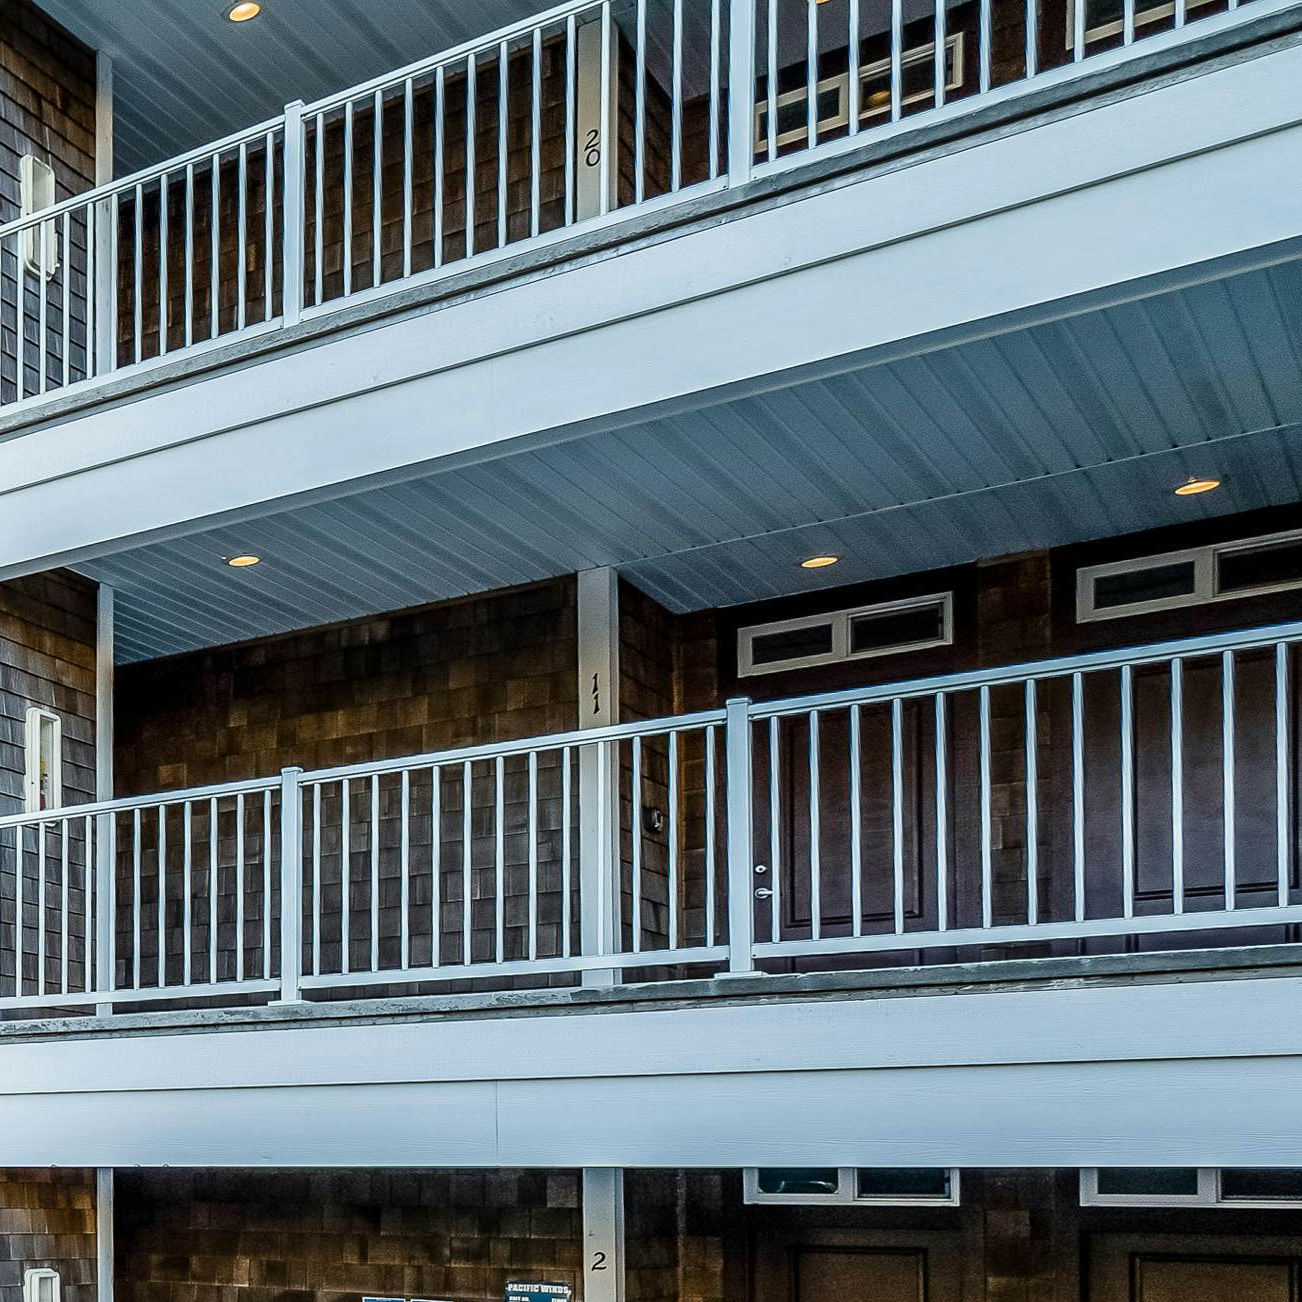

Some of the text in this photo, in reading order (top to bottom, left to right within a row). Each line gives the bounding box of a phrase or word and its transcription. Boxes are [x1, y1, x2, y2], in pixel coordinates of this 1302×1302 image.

[591, 1251, 608, 1271] 2
[507, 1283, 569, 1294] PACIFIC WINDS
